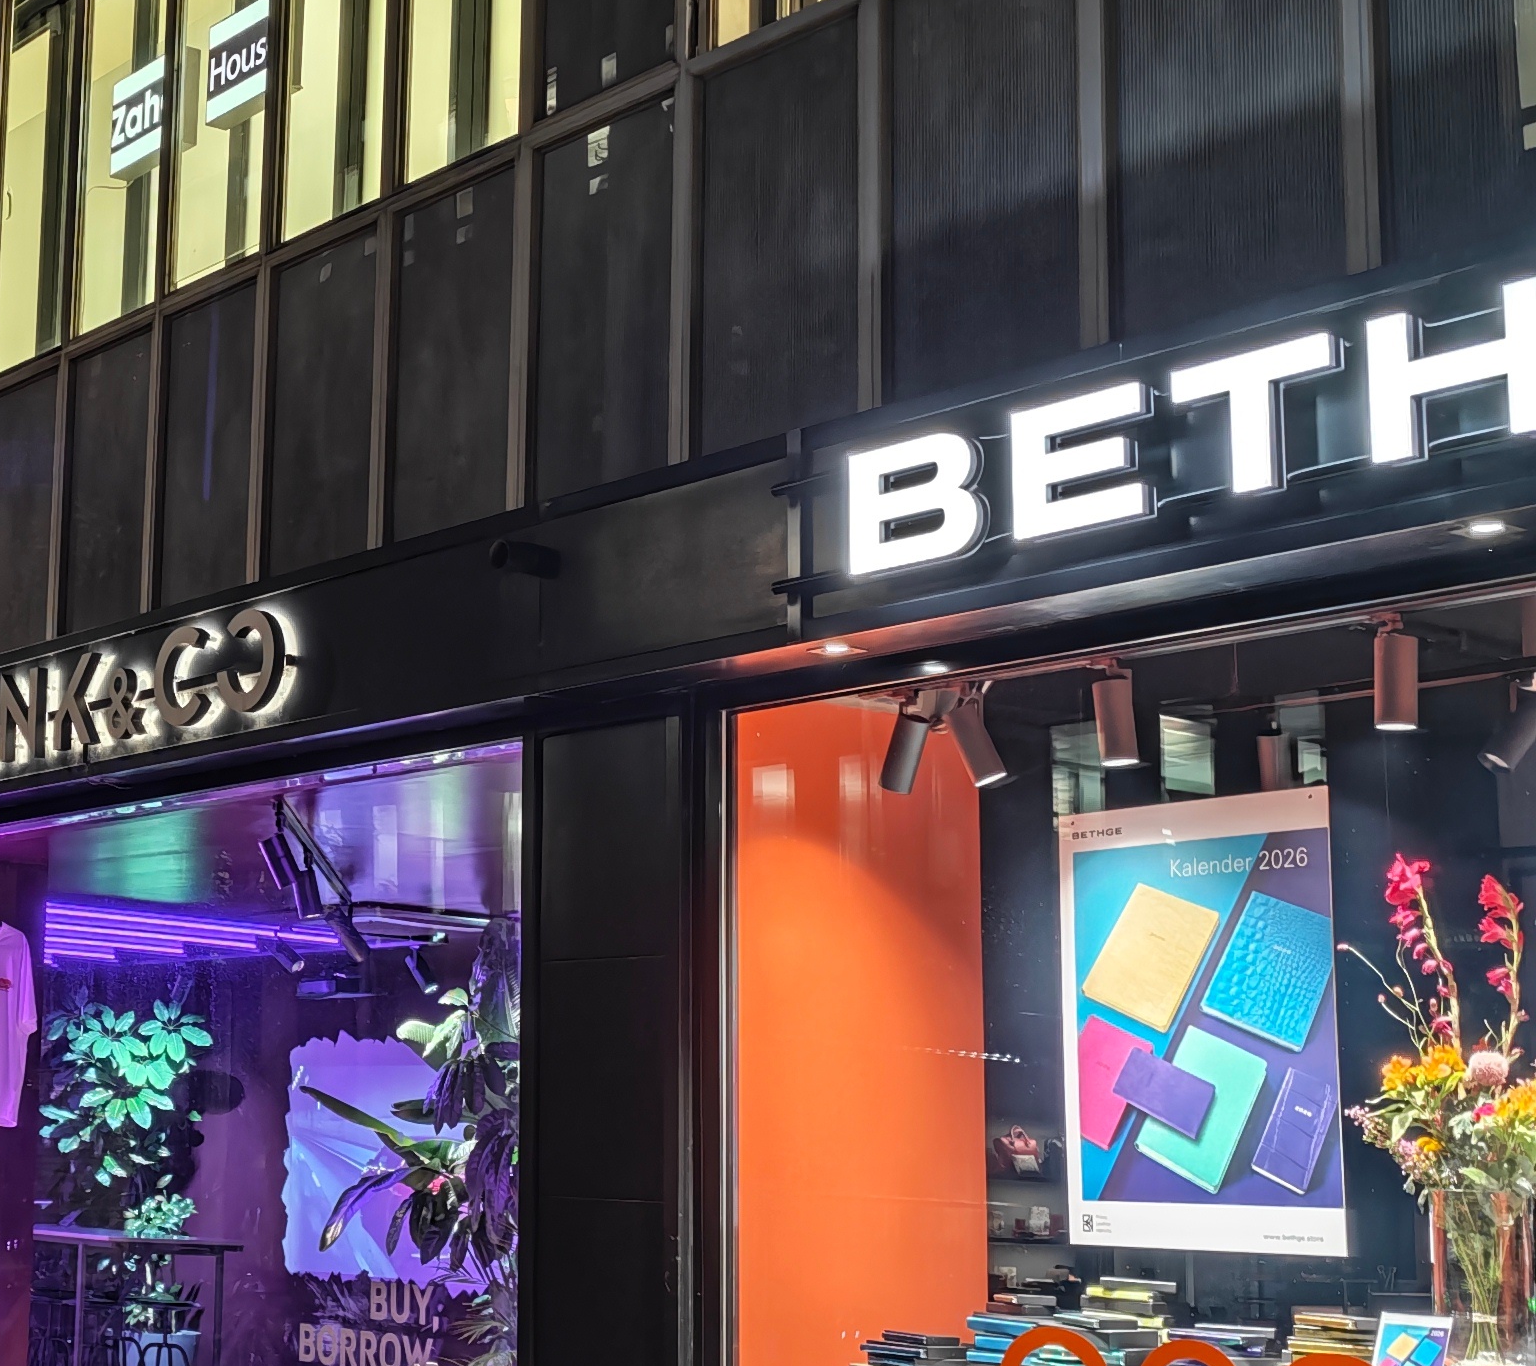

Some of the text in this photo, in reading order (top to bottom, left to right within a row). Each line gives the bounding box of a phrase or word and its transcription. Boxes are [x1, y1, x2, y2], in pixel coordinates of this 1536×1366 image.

[209, 36, 268, 93] Hous
[111, 89, 164, 149] Zah
[1071, 827, 1123, 840] BETHGE
[1170, 847, 1308, 878] Kalender 2026
[370, 1280, 440, 1333] BUY,
